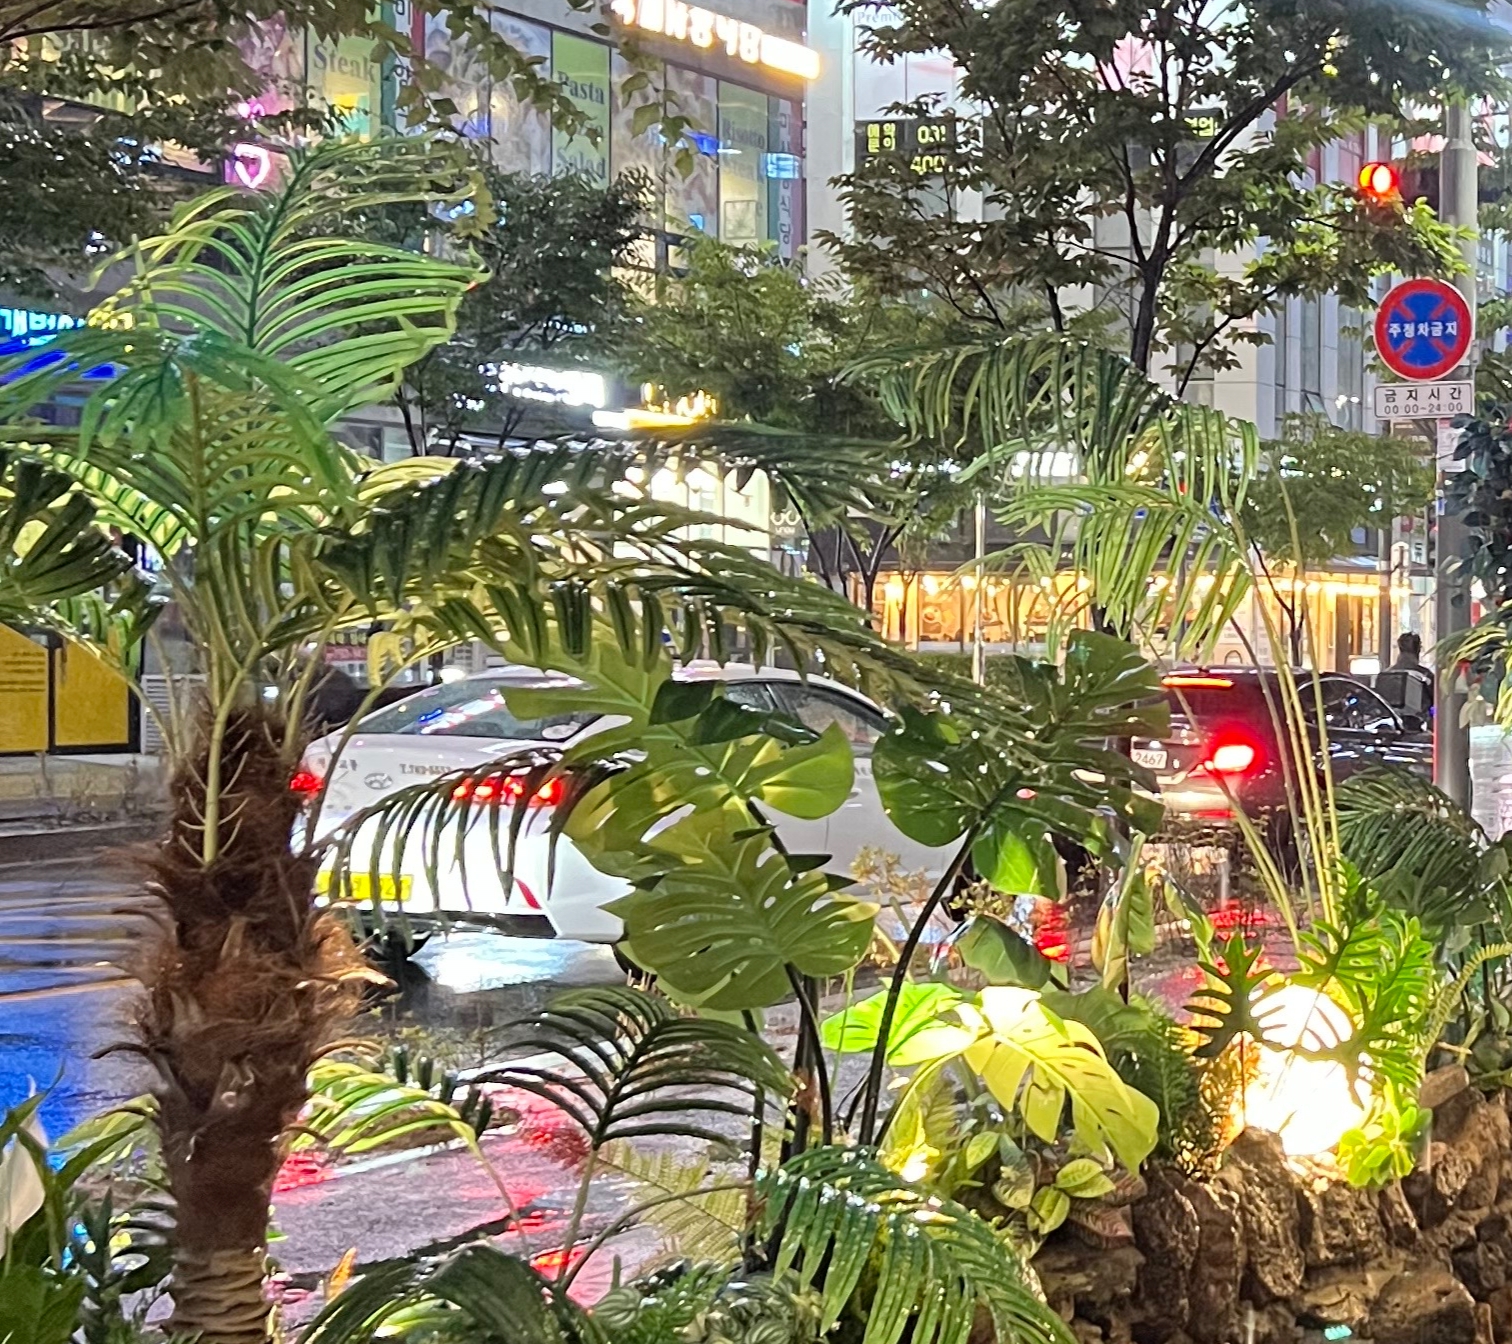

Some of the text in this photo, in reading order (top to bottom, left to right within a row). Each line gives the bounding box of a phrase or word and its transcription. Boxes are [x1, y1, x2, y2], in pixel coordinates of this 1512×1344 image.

[313, 42, 376, 83] Steak
[557, 70, 605, 105] Pasta
[1388, 321, 1457, 338] 주정차금지
[1135, 752, 1164, 766] 2467
